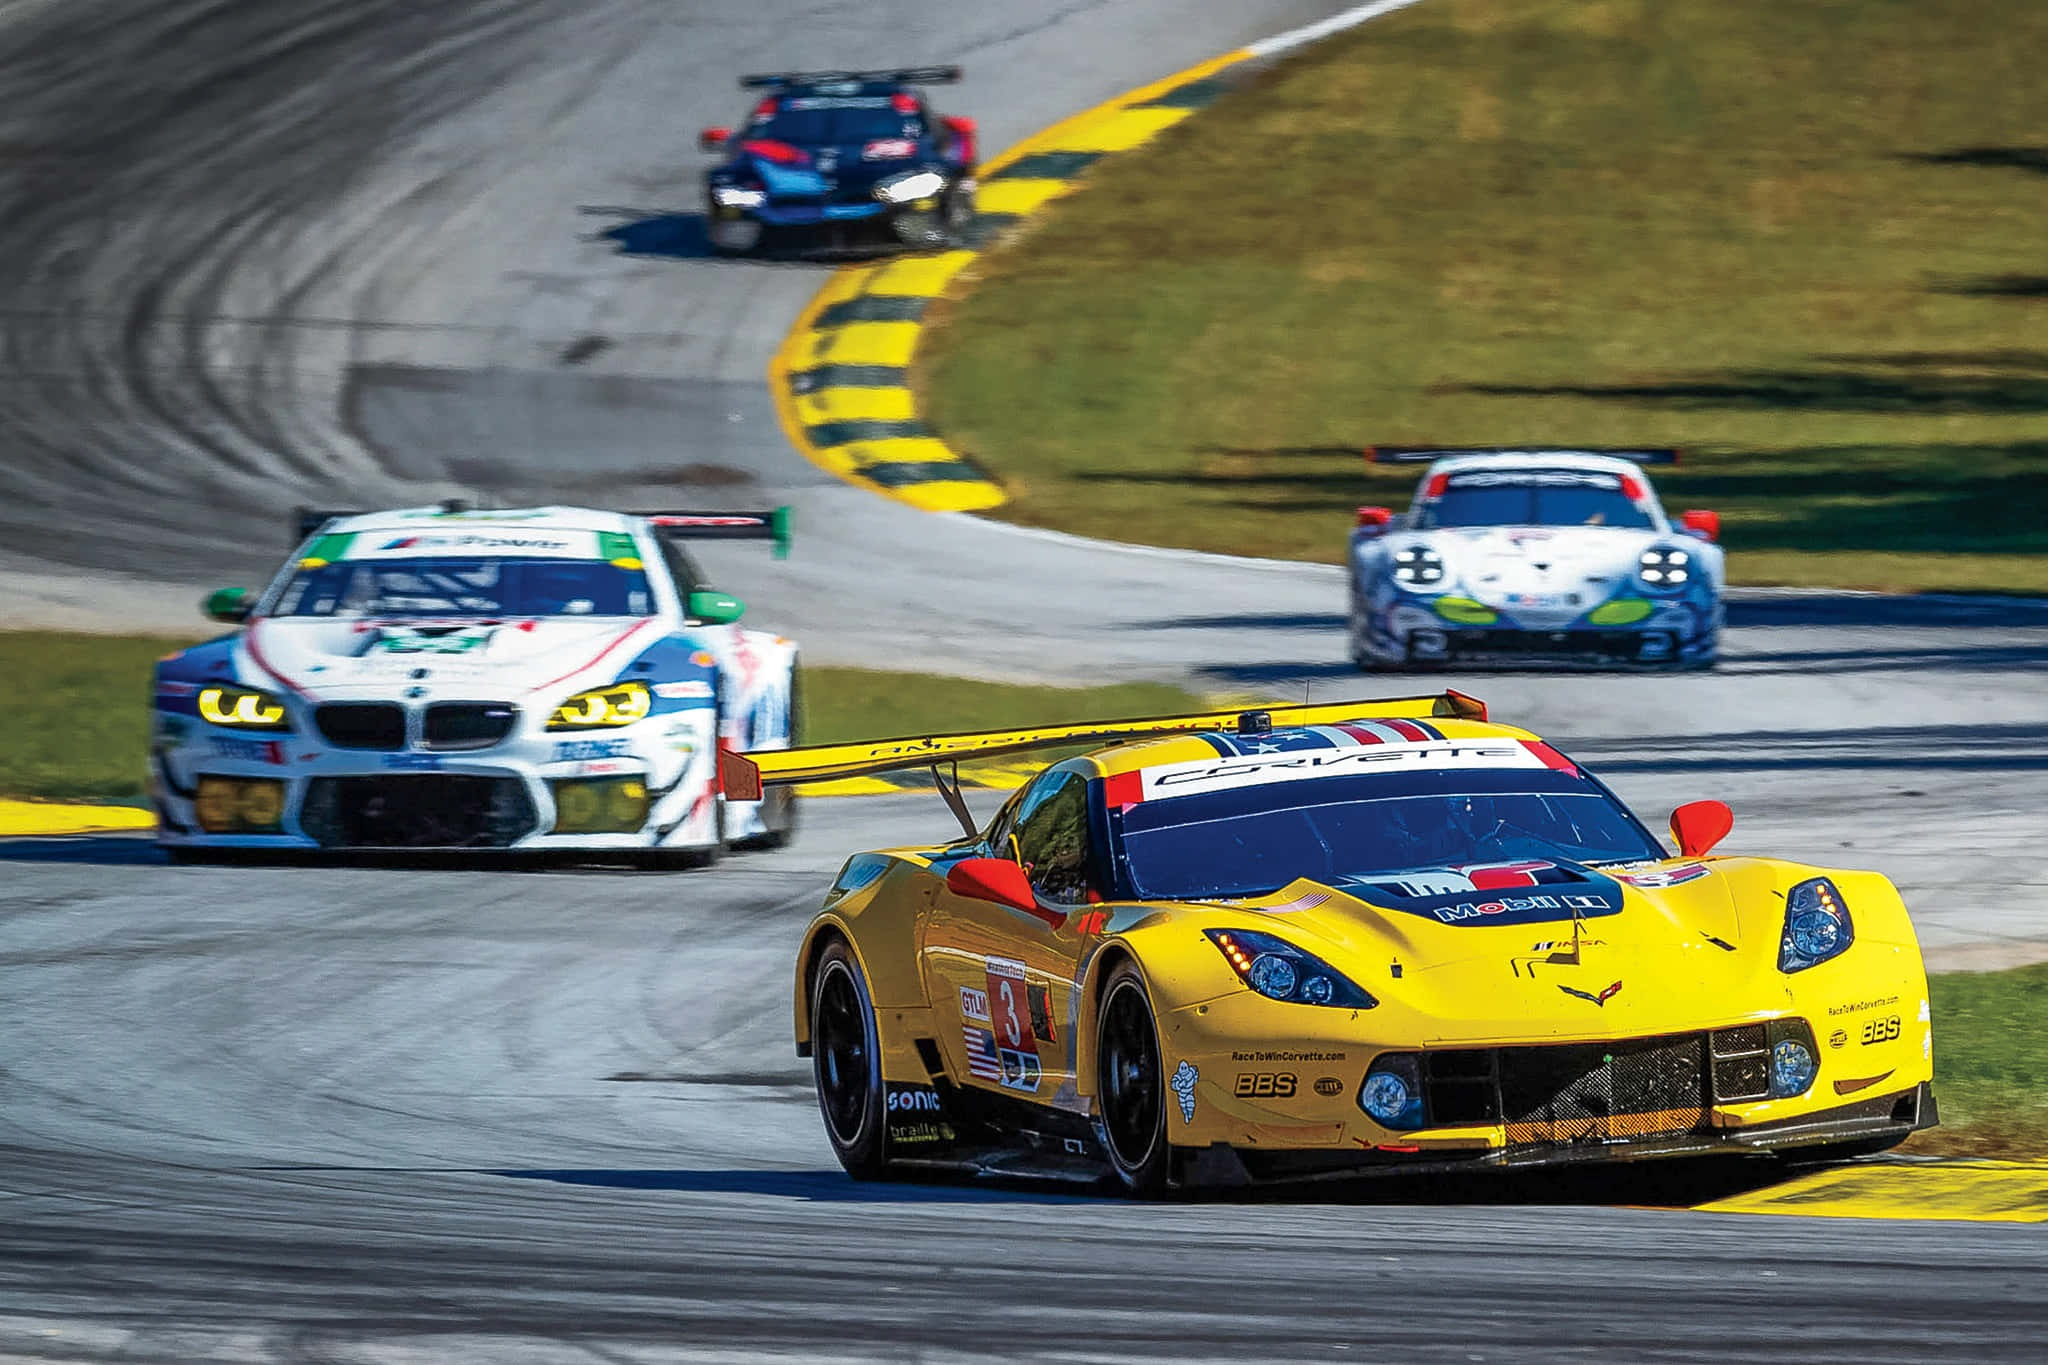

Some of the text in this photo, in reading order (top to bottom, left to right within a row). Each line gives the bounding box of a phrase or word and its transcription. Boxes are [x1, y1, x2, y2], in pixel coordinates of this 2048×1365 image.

[1155, 747, 1520, 786] CORVETTE
[1433, 896, 1561, 923] Mobil
[962, 991, 989, 1016] GTLM
[1000, 980, 1021, 1047] 3
[1861, 1015, 1900, 1046] BBS
[1231, 1051, 1346, 1062] RaceToWinCorvette.com
[1234, 1072, 1298, 1098] BBS
